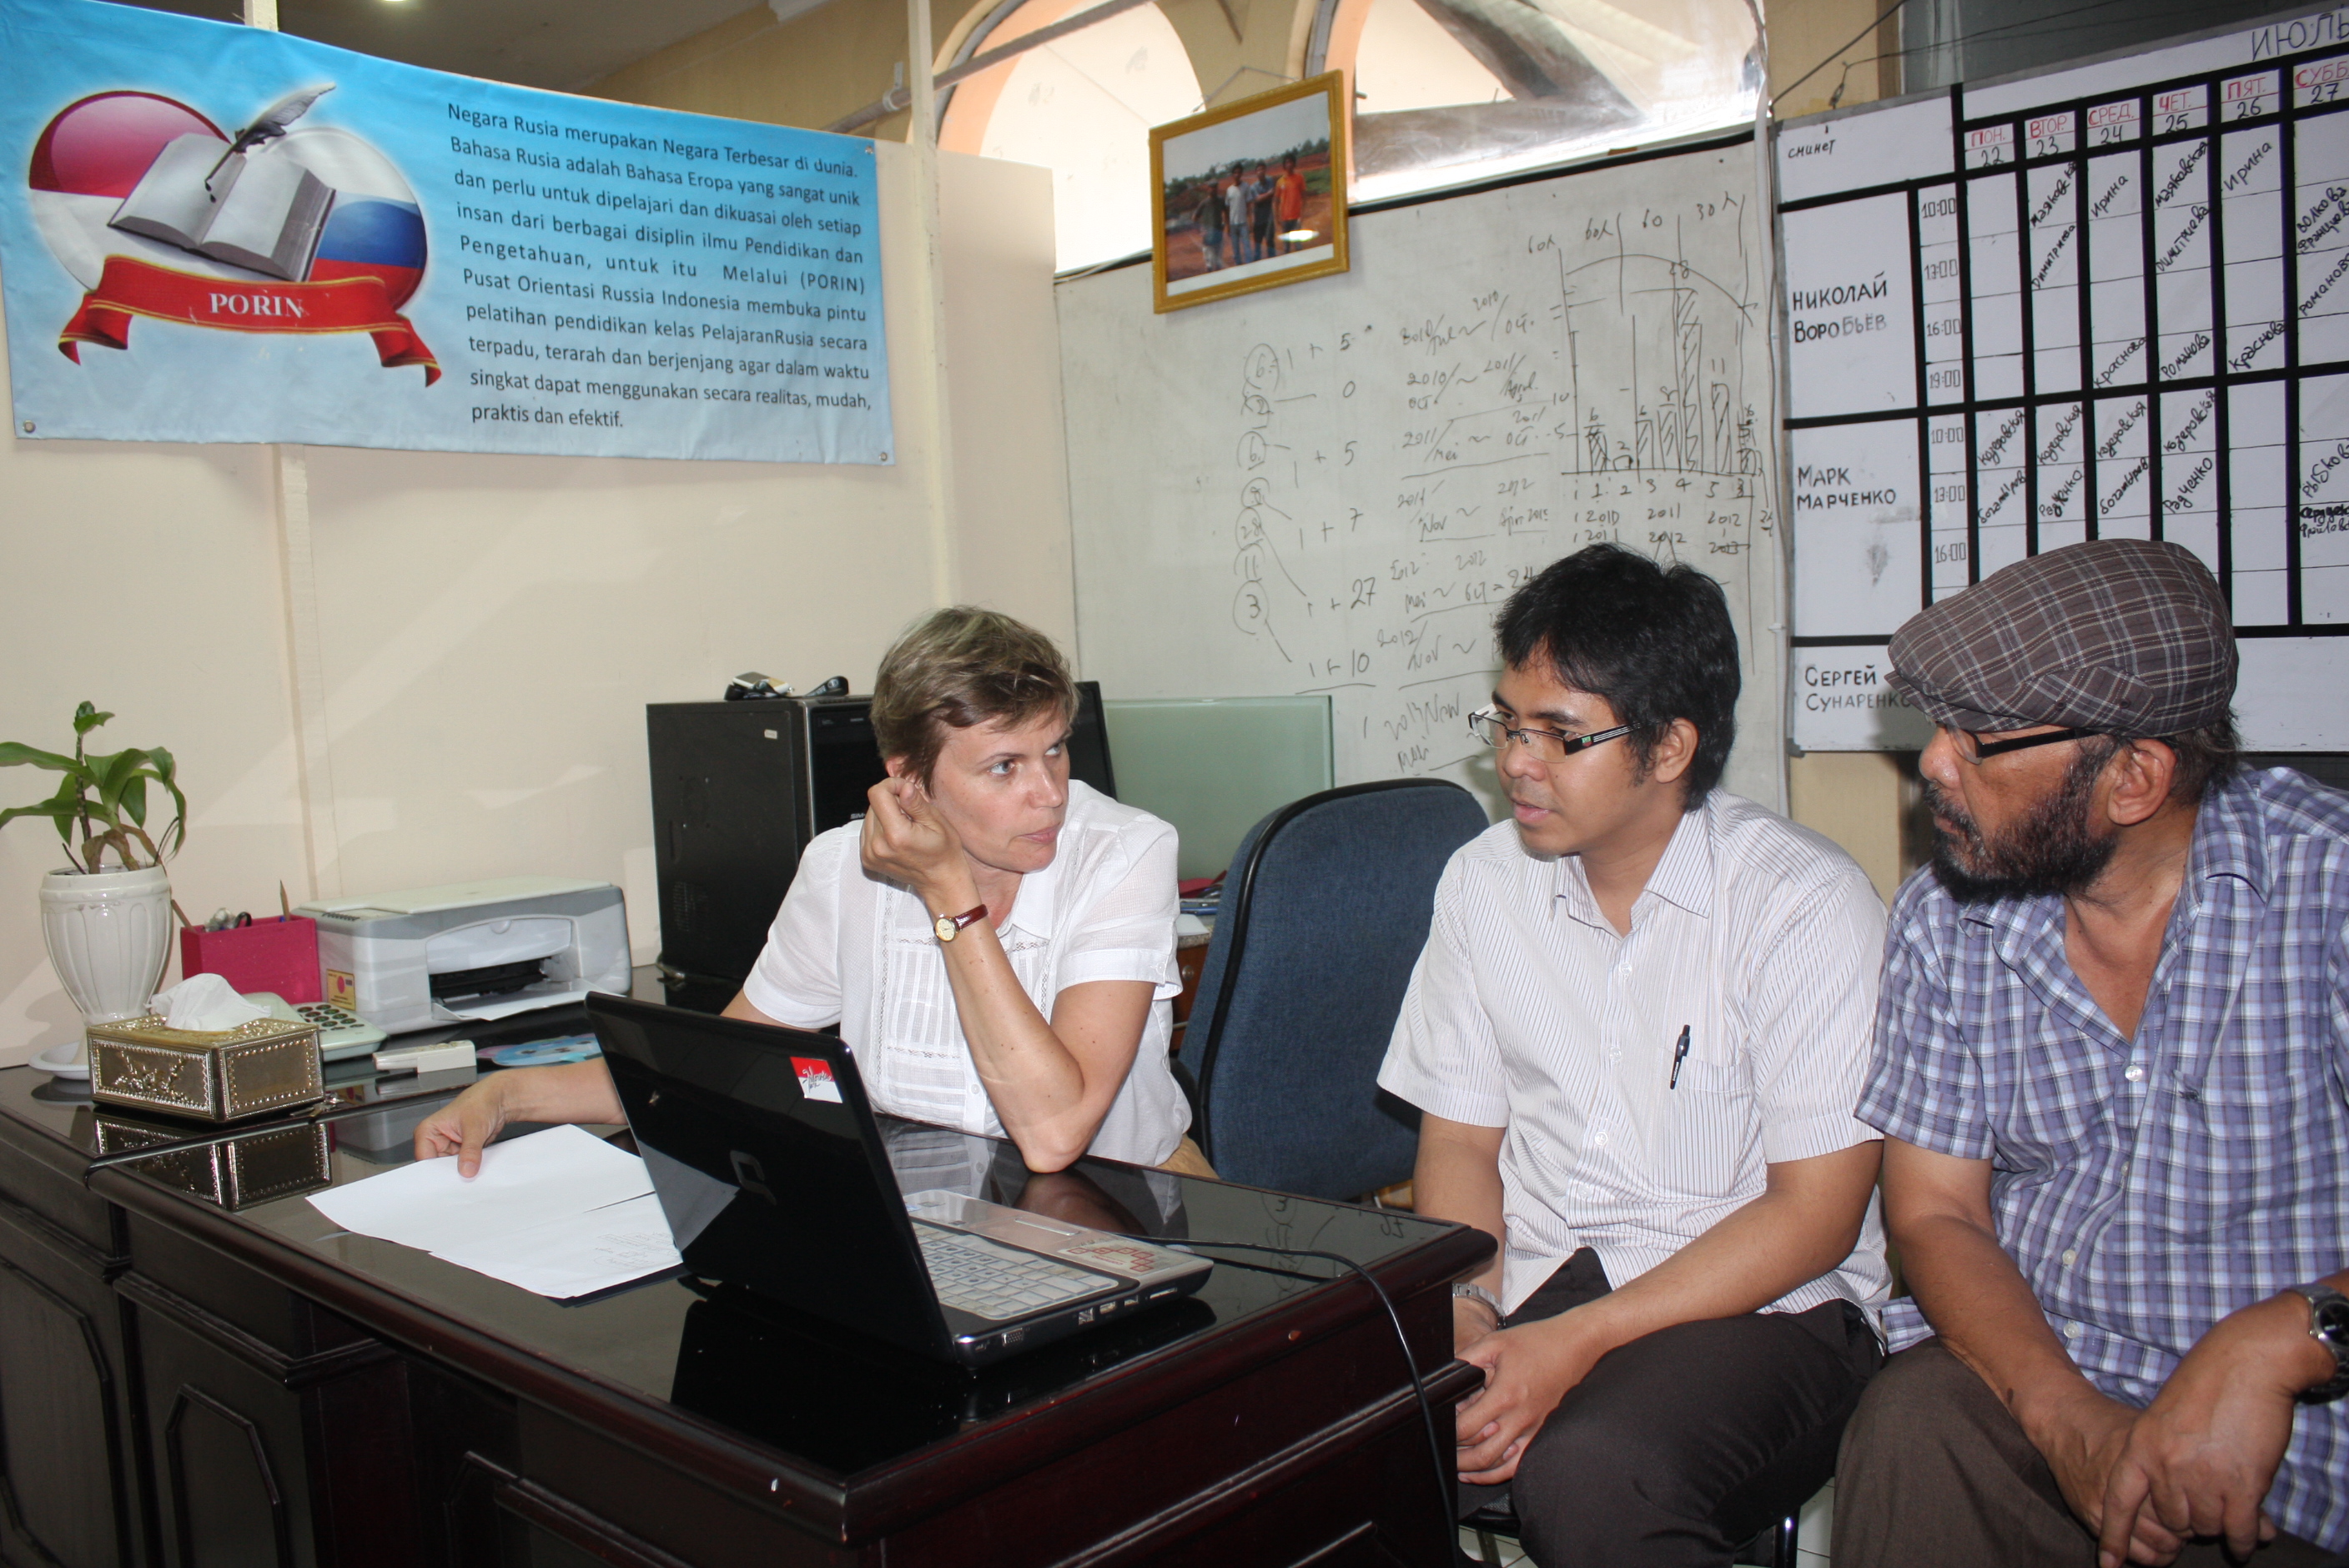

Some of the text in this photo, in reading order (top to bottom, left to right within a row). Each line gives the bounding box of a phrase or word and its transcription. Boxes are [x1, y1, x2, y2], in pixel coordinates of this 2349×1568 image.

[449, 103, 858, 178] Negara Rusia merupakan Negara Terbesar di dunia.
[1981, 82, 2340, 168] 22 23 24 25 26 27
[451, 137, 859, 205] Bahasa Rusia adalah Bahasa Eropa yang sangat unik
[455, 169, 860, 237] dan perlu untuk dipelajari dan dikuasai oleh setiap
[1921, 197, 1957, 219] 10:00
[457, 202, 862, 263] insan dari berbagai disiplin ilmu Pendidikan dan
[460, 235, 863, 294] Pengetahuan, untuk itu Melalui (PORIN)
[209, 293, 303, 319] PORIN
[464, 269, 865, 321] Pusat Orientasi Russia Indonesia membuka pintu
[467, 304, 867, 349] pelatihan pendidikan kelas PelajaranRusia secara
[1926, 318, 1962, 337] 16:00
[469, 337, 868, 379] terpadu, terarah dan berjenjang agar dalam waktu
[470, 369, 870, 410] singkat dapat menggunakan secara realitas, mudah,
[1929, 369, 1961, 389] 19:00
[472, 404, 622, 427] praktis dan efektif.
[1930, 425, 1964, 445] 10:00
[1797, 488, 1896, 511] МАРЧЕНКО
[1935, 542, 1966, 564] 16:00
